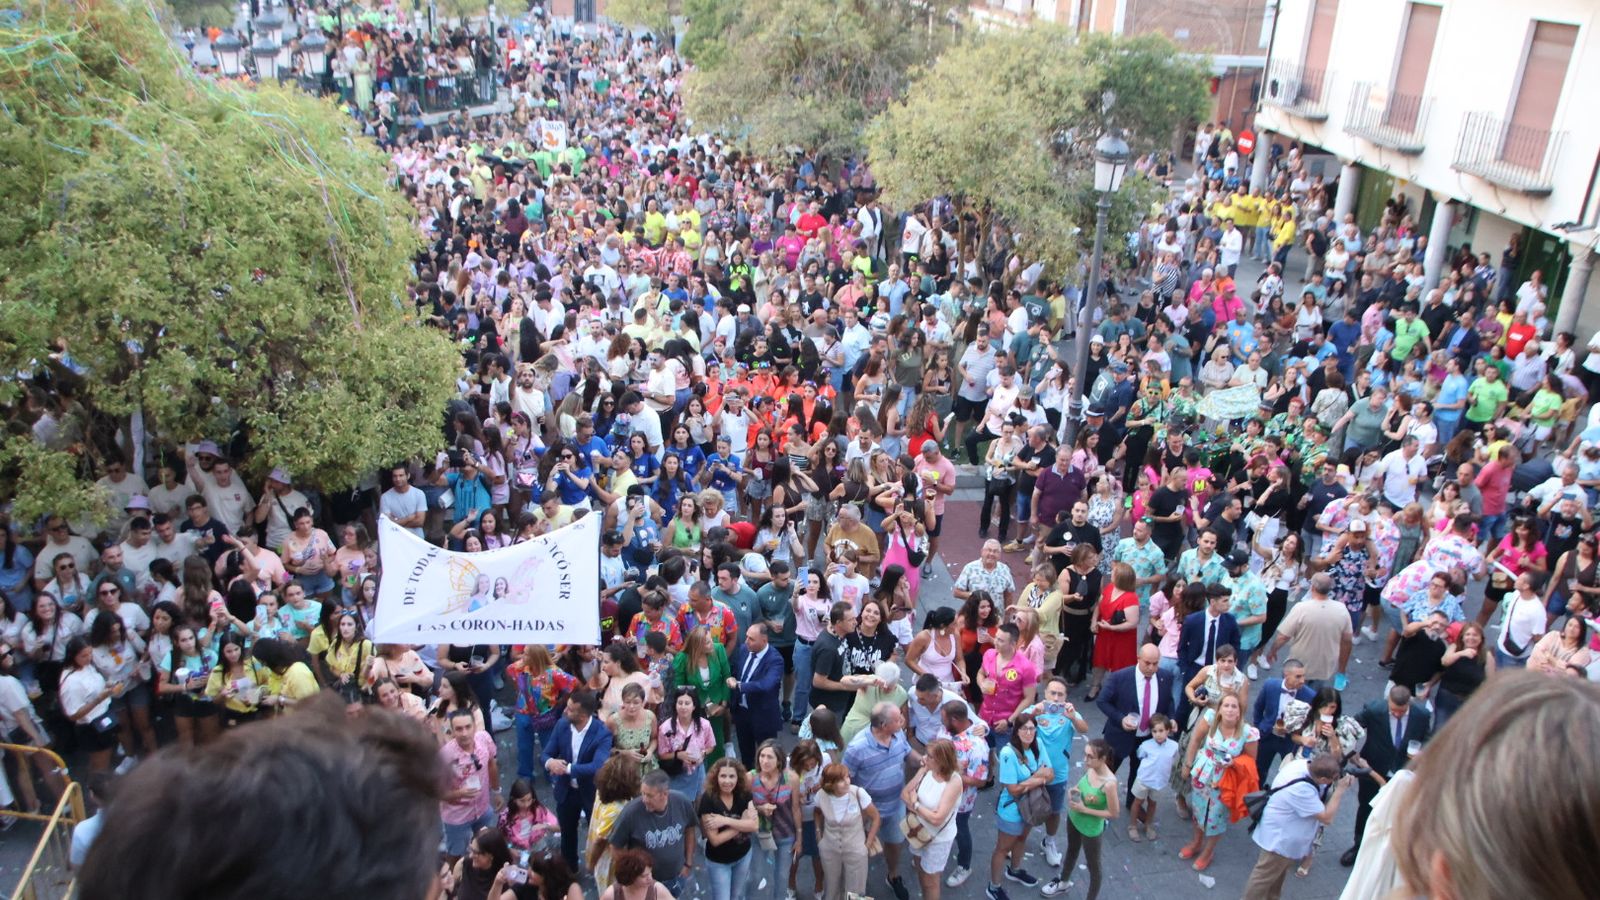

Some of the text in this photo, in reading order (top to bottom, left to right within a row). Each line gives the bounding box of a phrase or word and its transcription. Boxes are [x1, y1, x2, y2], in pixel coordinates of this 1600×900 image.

[403, 547, 440, 605] DE TODAS
[559, 573, 571, 599] SER
[450, 619, 565, 632] CORON-HADAS
